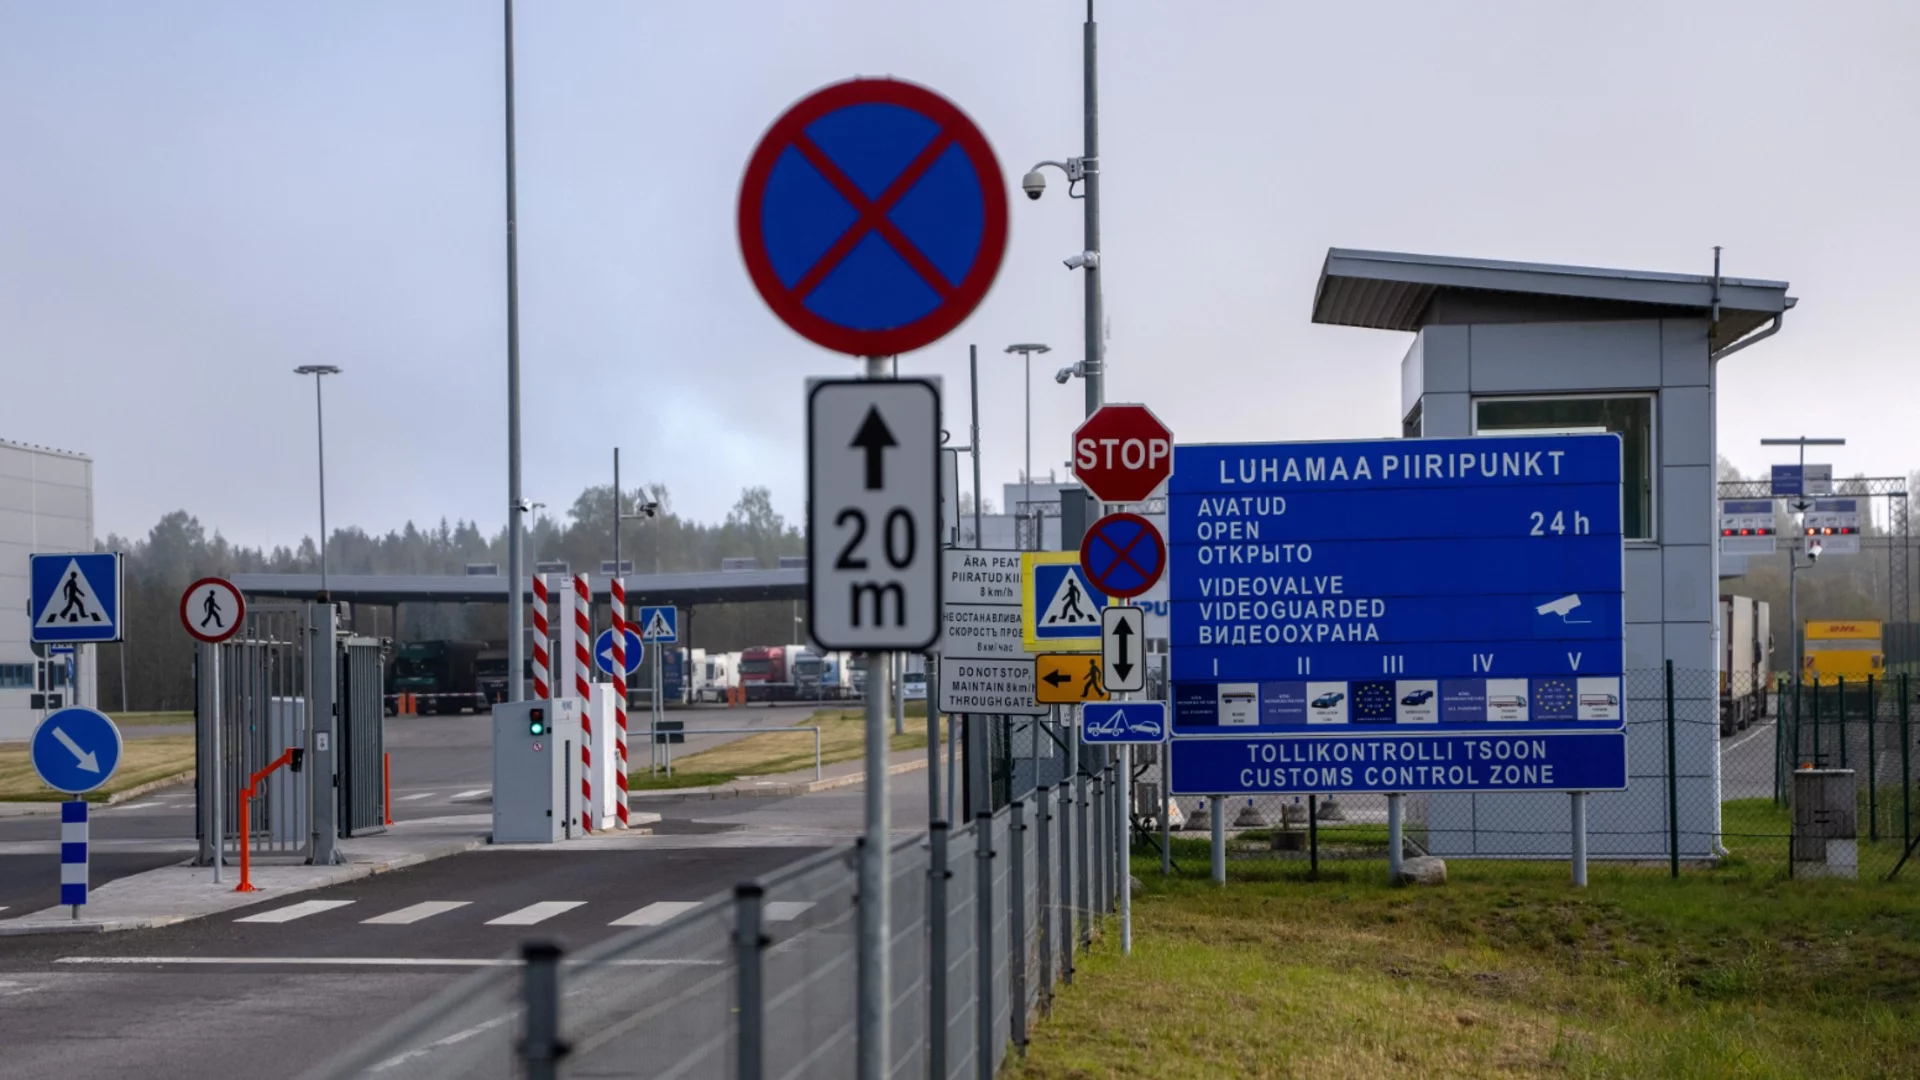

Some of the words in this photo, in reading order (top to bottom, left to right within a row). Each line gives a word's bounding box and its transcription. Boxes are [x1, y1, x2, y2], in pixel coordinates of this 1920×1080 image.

[1076, 437, 1169, 470] STOP
[1220, 456, 1373, 484] LUHAMAA
[1382, 450, 1565, 480] PIIRIPUNKT
[1197, 496, 1286, 517] AVATUD
[834, 506, 917, 571] 20
[1197, 520, 1260, 541] OPEN
[963, 554, 988, 568] ÄRA
[1197, 543, 1313, 565] ОТКРЫТО
[951, 571, 1003, 584] PIIRATUD
[1198, 575, 1344, 597] VIDEOVALVE
[987, 586, 1014, 597] km/h
[850, 580, 906, 629] m
[1199, 598, 1386, 622] VIDEOGUARDED
[1199, 623, 1380, 647] ВИДЕООХРАНА
[958, 666, 974, 678] DO
[975, 667, 998, 679] NOT
[1213, 658, 1218, 677] I
[1297, 656, 1311, 676] II
[1383, 655, 1404, 674] III
[1473, 653, 1494, 673] IV
[1567, 651, 1583, 671] V
[952, 681, 1004, 693] MAINTAIN
[949, 695, 1002, 707] THROUGH
[1247, 741, 1453, 763] TOLLIKONTROLLI
[1463, 740, 1547, 761] TSOON
[1240, 766, 1353, 787] CUSTOMS
[1364, 765, 1479, 786] CONTROL
[1489, 764, 1554, 785] ZONE
